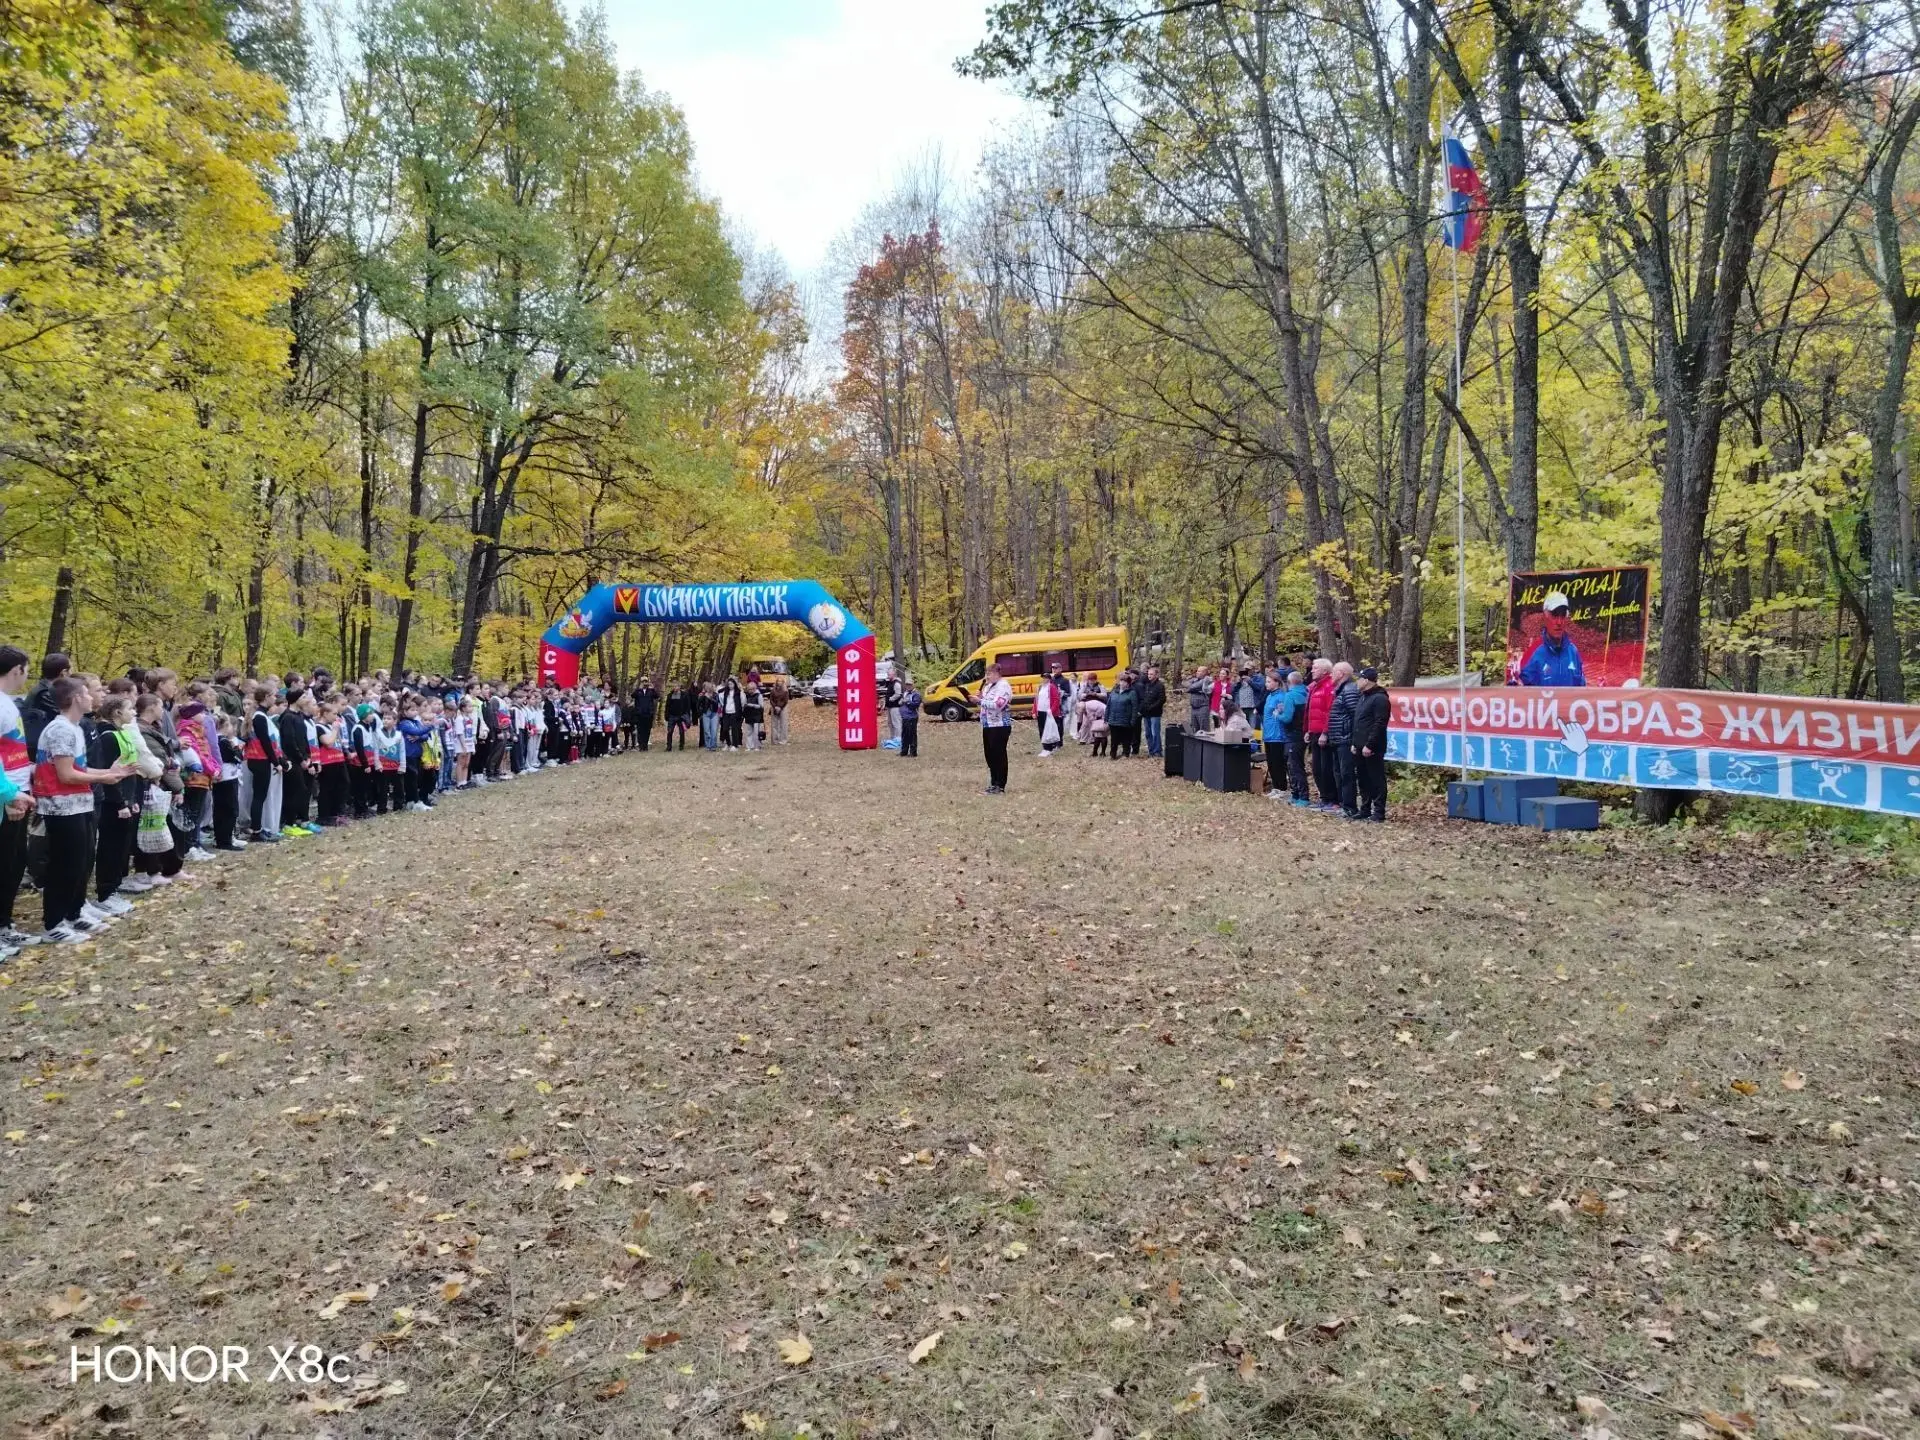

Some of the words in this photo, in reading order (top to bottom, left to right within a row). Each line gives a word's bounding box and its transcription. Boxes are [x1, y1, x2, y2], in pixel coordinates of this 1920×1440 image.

[644, 585, 789, 616] БОРИСОГЛЕБСК
[844, 649, 863, 742] ФИНИШ
[1400, 690, 1560, 731] ЗДОРОВЫЙ
[1569, 699, 1704, 738] ОБРАЗ
[1455, 785, 1469, 814] 2
